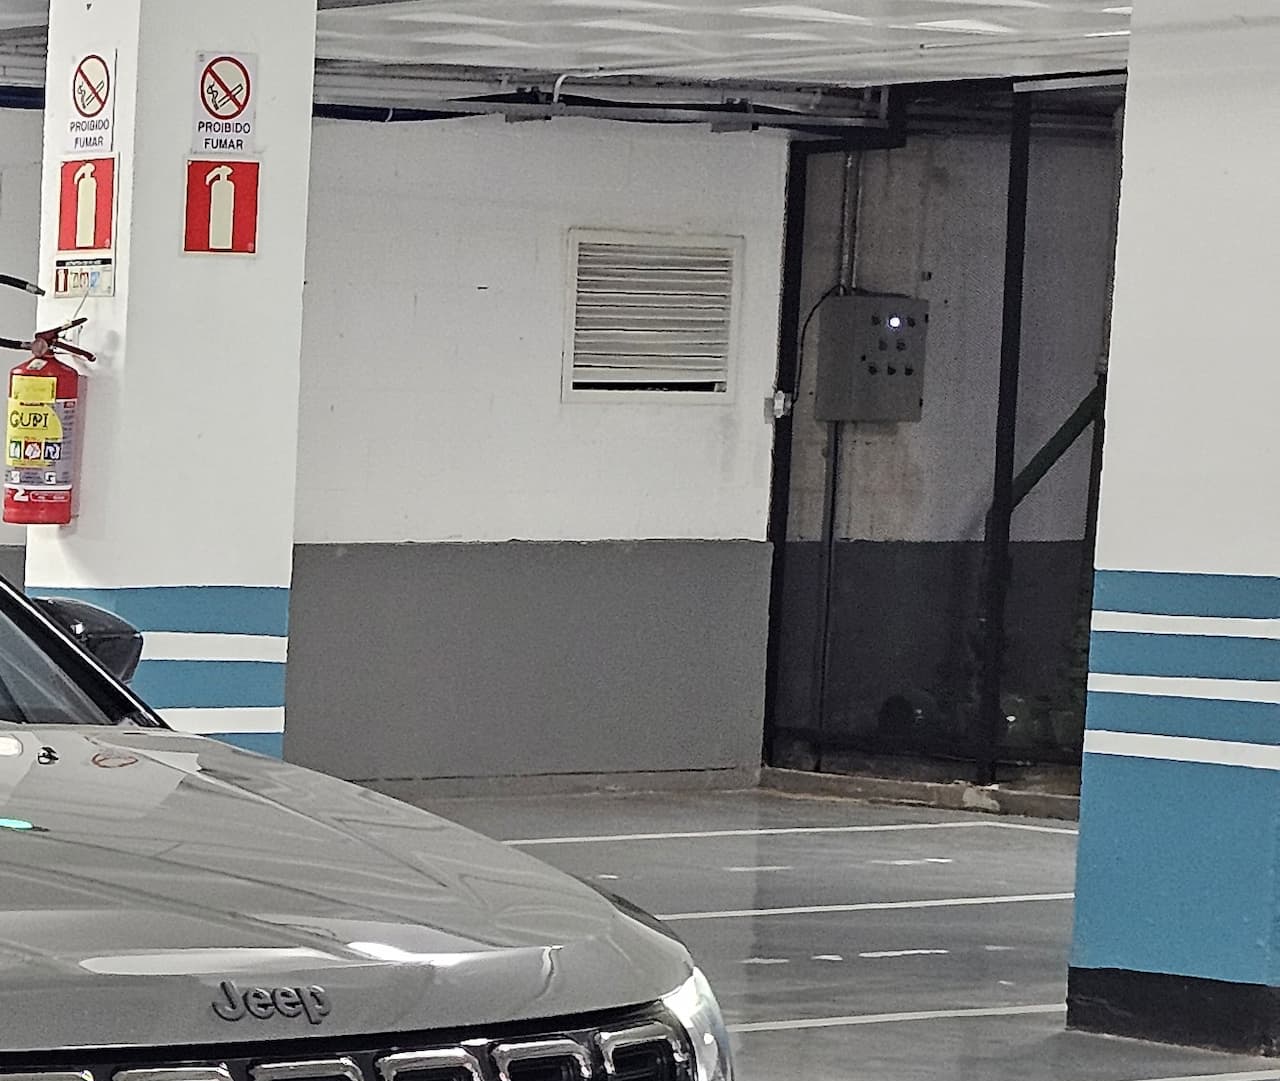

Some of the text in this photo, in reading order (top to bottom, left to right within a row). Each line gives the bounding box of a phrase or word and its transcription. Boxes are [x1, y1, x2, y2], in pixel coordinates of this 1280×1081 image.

[70, 119, 110, 132] PROIBIDO
[198, 121, 251, 134] PROIBIDO
[74, 136, 104, 148] FUMAR
[204, 138, 244, 150] FUMAR
[211, 981, 332, 1025] Jeep
